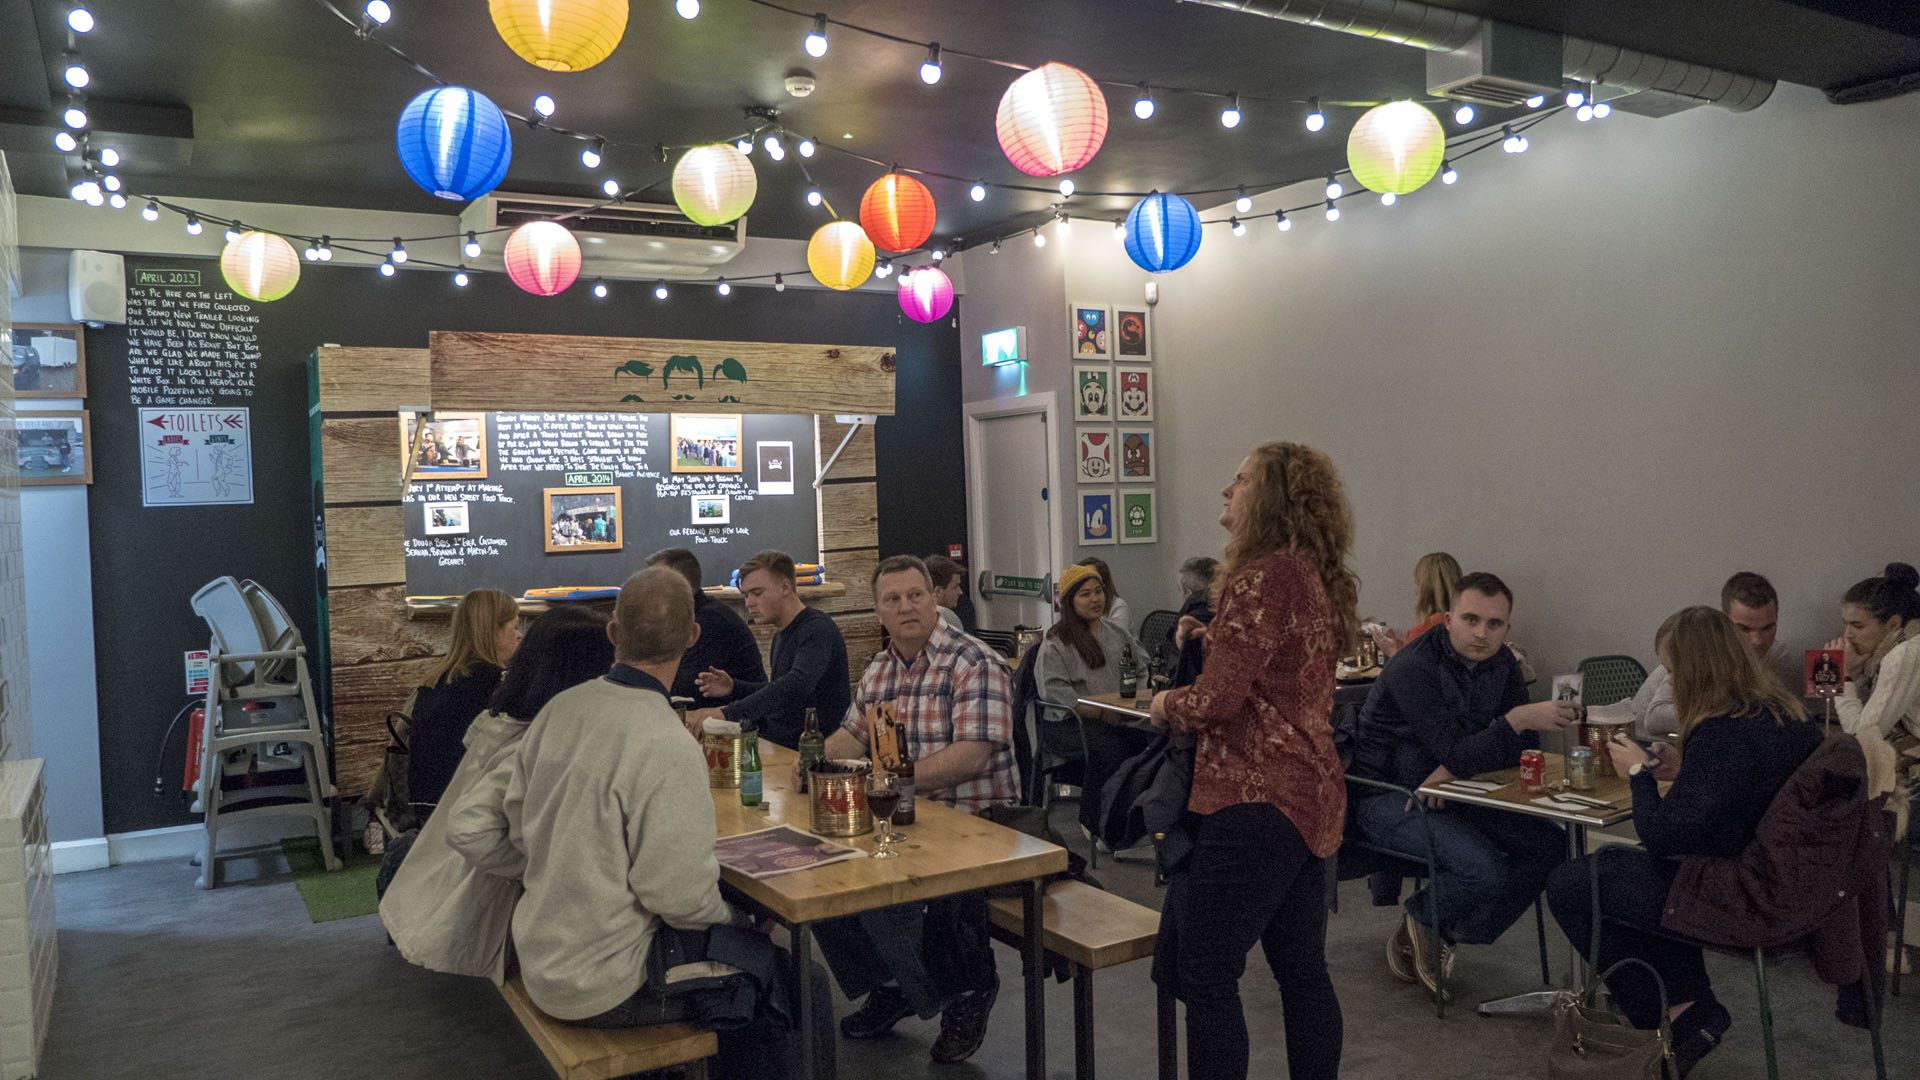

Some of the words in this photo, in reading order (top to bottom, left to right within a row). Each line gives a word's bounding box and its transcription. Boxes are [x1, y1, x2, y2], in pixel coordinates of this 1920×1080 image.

[141, 272, 166, 284] APRIL
[170, 273, 196, 284] 2013
[130, 288, 145, 297] THIS
[150, 288, 161, 298] PIC
[166, 290, 181, 298] HERE
[200, 292, 211, 300] THE
[143, 299, 156, 307] THE
[162, 300, 175, 308] DAY
[214, 303, 250, 312] COLLECTED
[146, 309, 169, 317] BRAND
[174, 311, 192, 320] NEW
[228, 314, 260, 324] LOOKING
[162, 319, 173, 327] WE
[177, 320, 196, 329] KNEW
[220, 323, 254, 332] DIFFICULT
[129, 328, 138, 336] IT
[141, 329, 165, 337] WOULD
[182, 330, 185, 338] I
[210, 331, 230, 340] KNOW
[233, 334, 257, 342] WOULD
[127, 338, 140, 346] WE
[144, 339, 162, 348] HAVE
[167, 339, 184, 348] BEEN
[227, 341, 240, 350] BUT
[244, 343, 259, 351] BOY
[129, 348, 142, 356] ARE
[162, 348, 182, 358] GLAD
[186, 350, 198, 358] WE
[201, 350, 221, 359] MADE
[129, 366, 138, 375] TO
[143, 367, 162, 375] MOST
[227, 370, 245, 378] JUST
[249, 370, 254, 378] A
[191, 377, 205, 385] OUR
[219, 388, 241, 396] GOING
[131, 396, 142, 405] BE
[147, 396, 153, 404] A
[155, 396, 176, 404] GAME
[169, 413, 223, 432] TOILETS
[568, 475, 591, 484] APRIL
[592, 474, 611, 483] 2014
[468, 484, 476, 492] AT
[483, 494, 496, 502] FOOD
[736, 527, 749, 535] LOOK
